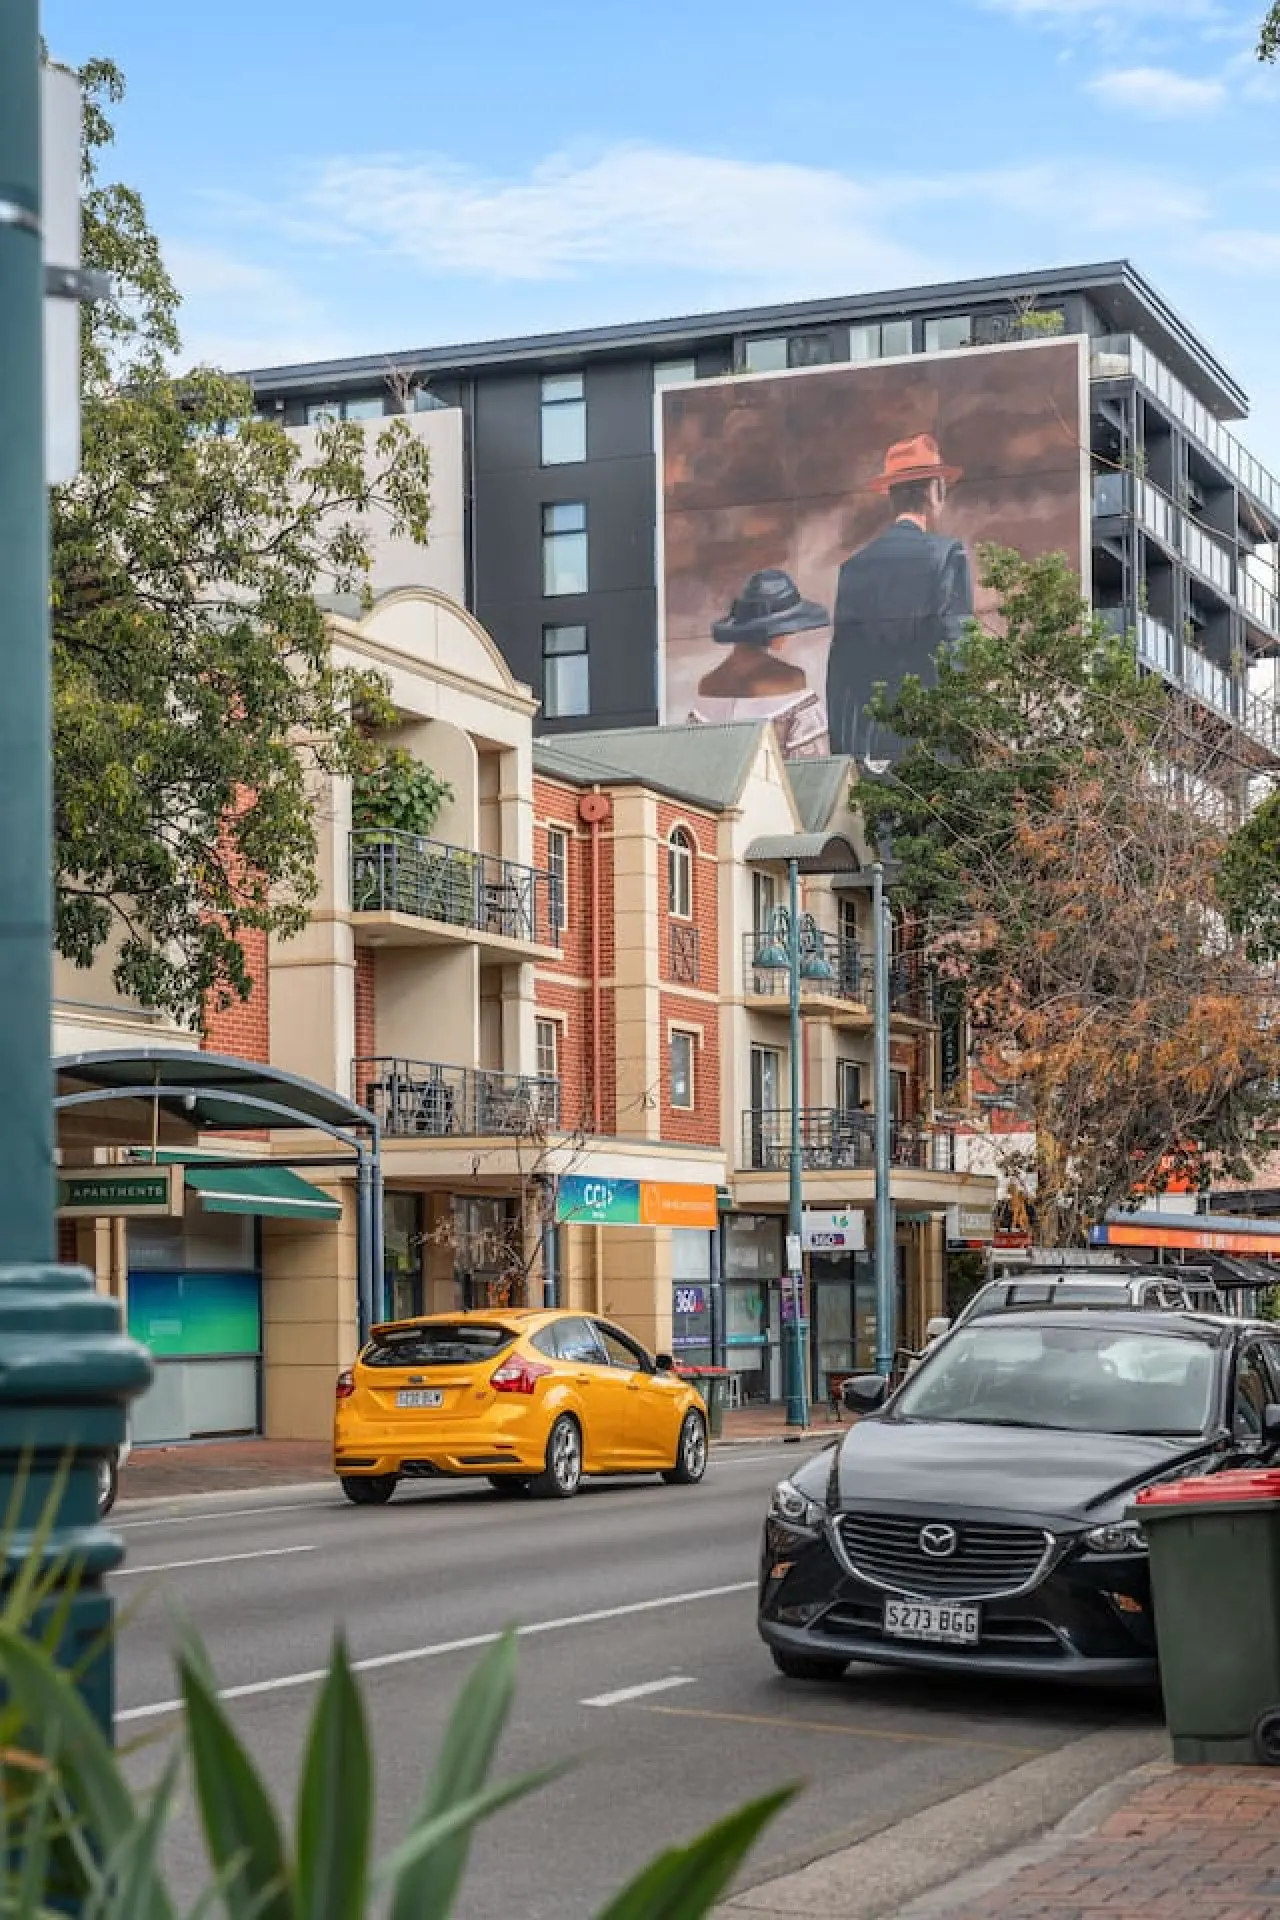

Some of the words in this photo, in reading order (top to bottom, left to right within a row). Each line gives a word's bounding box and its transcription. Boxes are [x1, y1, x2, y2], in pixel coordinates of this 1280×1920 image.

[73, 1185, 163, 1197] APARTMENTS
[888, 1605, 931, 1628] S273
[939, 1609, 975, 1632] BGG
